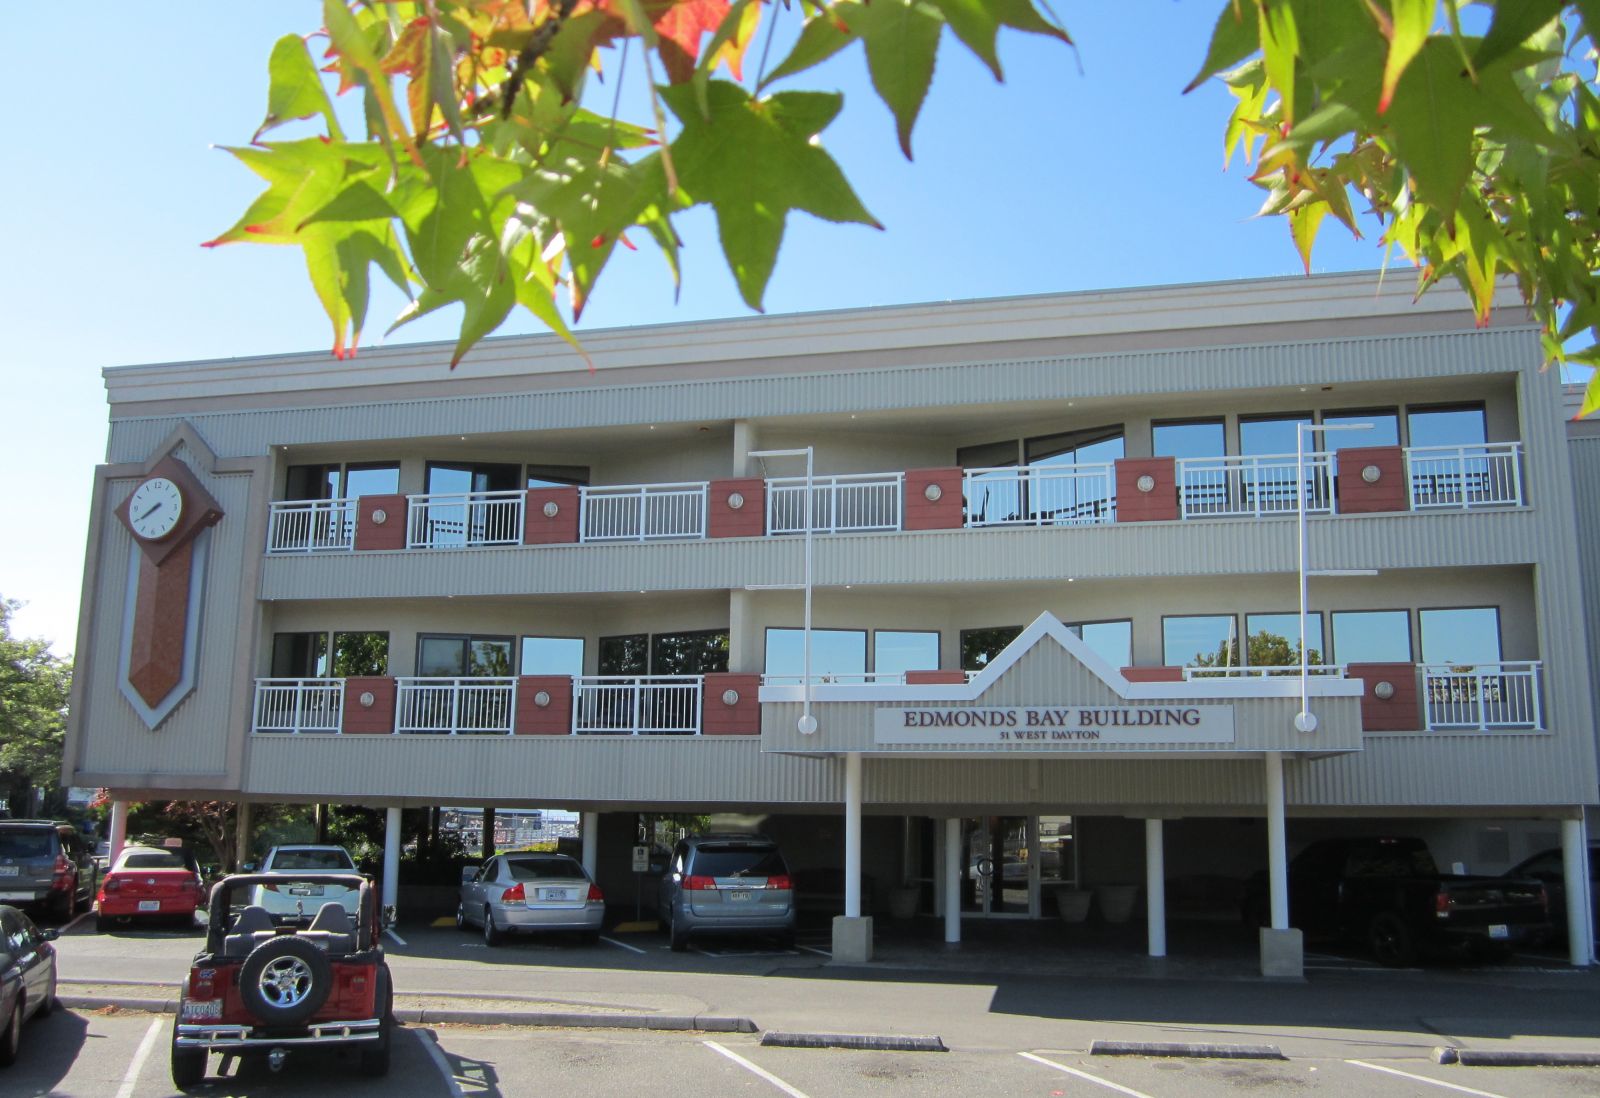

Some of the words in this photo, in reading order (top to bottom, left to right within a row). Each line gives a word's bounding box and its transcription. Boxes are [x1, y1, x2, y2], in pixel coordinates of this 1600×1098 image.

[154, 481, 162, 489] 12
[904, 710, 1017, 727] EDMONDS
[1026, 710, 1069, 727] BAY
[1079, 709, 1200, 726] BUILDING
[1000, 731, 1009, 740] 51
[1014, 730, 1047, 740] WEST
[1051, 730, 1100, 740] DAYTON
